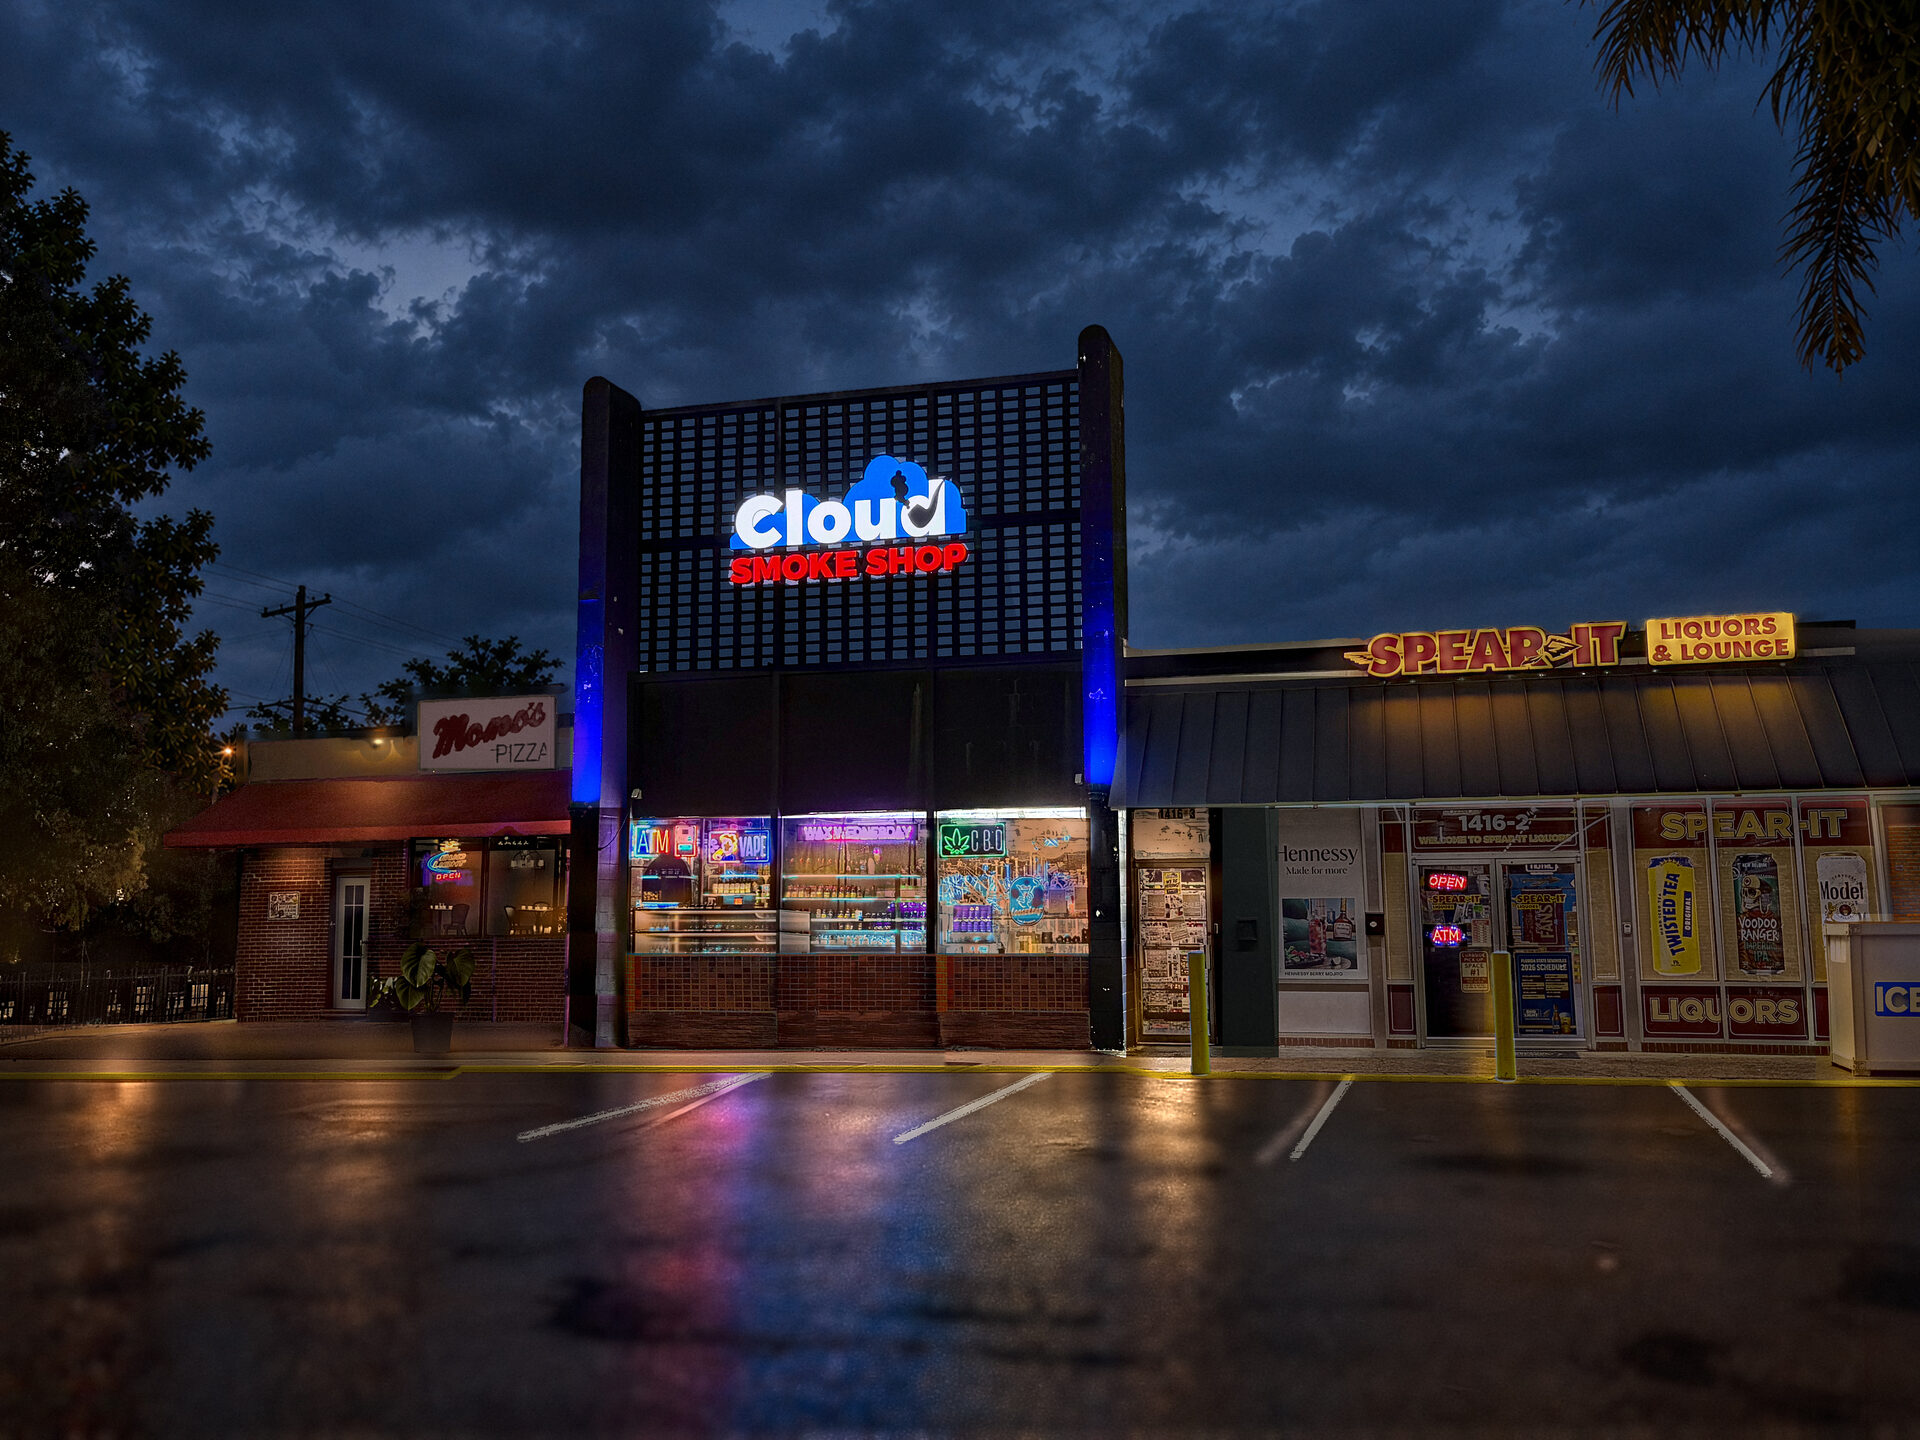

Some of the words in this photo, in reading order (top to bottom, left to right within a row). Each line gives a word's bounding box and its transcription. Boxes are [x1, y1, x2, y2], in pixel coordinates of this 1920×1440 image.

[735, 478, 946, 549] Cloud
[730, 550, 858, 584] SMOKE
[865, 543, 967, 576] SHOP
[1660, 616, 1778, 641] LIQUORS
[1652, 644, 1672, 662] &
[1680, 638, 1790, 661] LOUNGE
[496, 742, 548, 763] PIZZA
[1458, 814, 1531, 832] 1416-2
[1660, 809, 1848, 840] SPEAR-IT
[636, 827, 671, 856] ATM
[739, 833, 767, 860] VAPE
[1275, 845, 1359, 865] Hennessy
[435, 872, 462, 881] OPEN
[1286, 866, 1310, 875] Made
[1311, 866, 1322, 875] for
[1325, 867, 1348, 875] more
[1428, 875, 1467, 889] OPEN
[1662, 872, 1681, 896] TEA
[1684, 898, 1692, 932] ORIGINAL
[1738, 916, 1778, 929] VOODOO
[1431, 929, 1460, 942] ATM
[1662, 898, 1687, 956] TWISTED
[1740, 929, 1779, 942] RANGER
[1537, 963, 1568, 971] SCHEDULE
[1753, 951, 1770, 962] IPA
[1470, 968, 1480, 976] #1
[1650, 997, 1800, 1024] LIQUORS
[1876, 986, 1920, 1013] ICE
